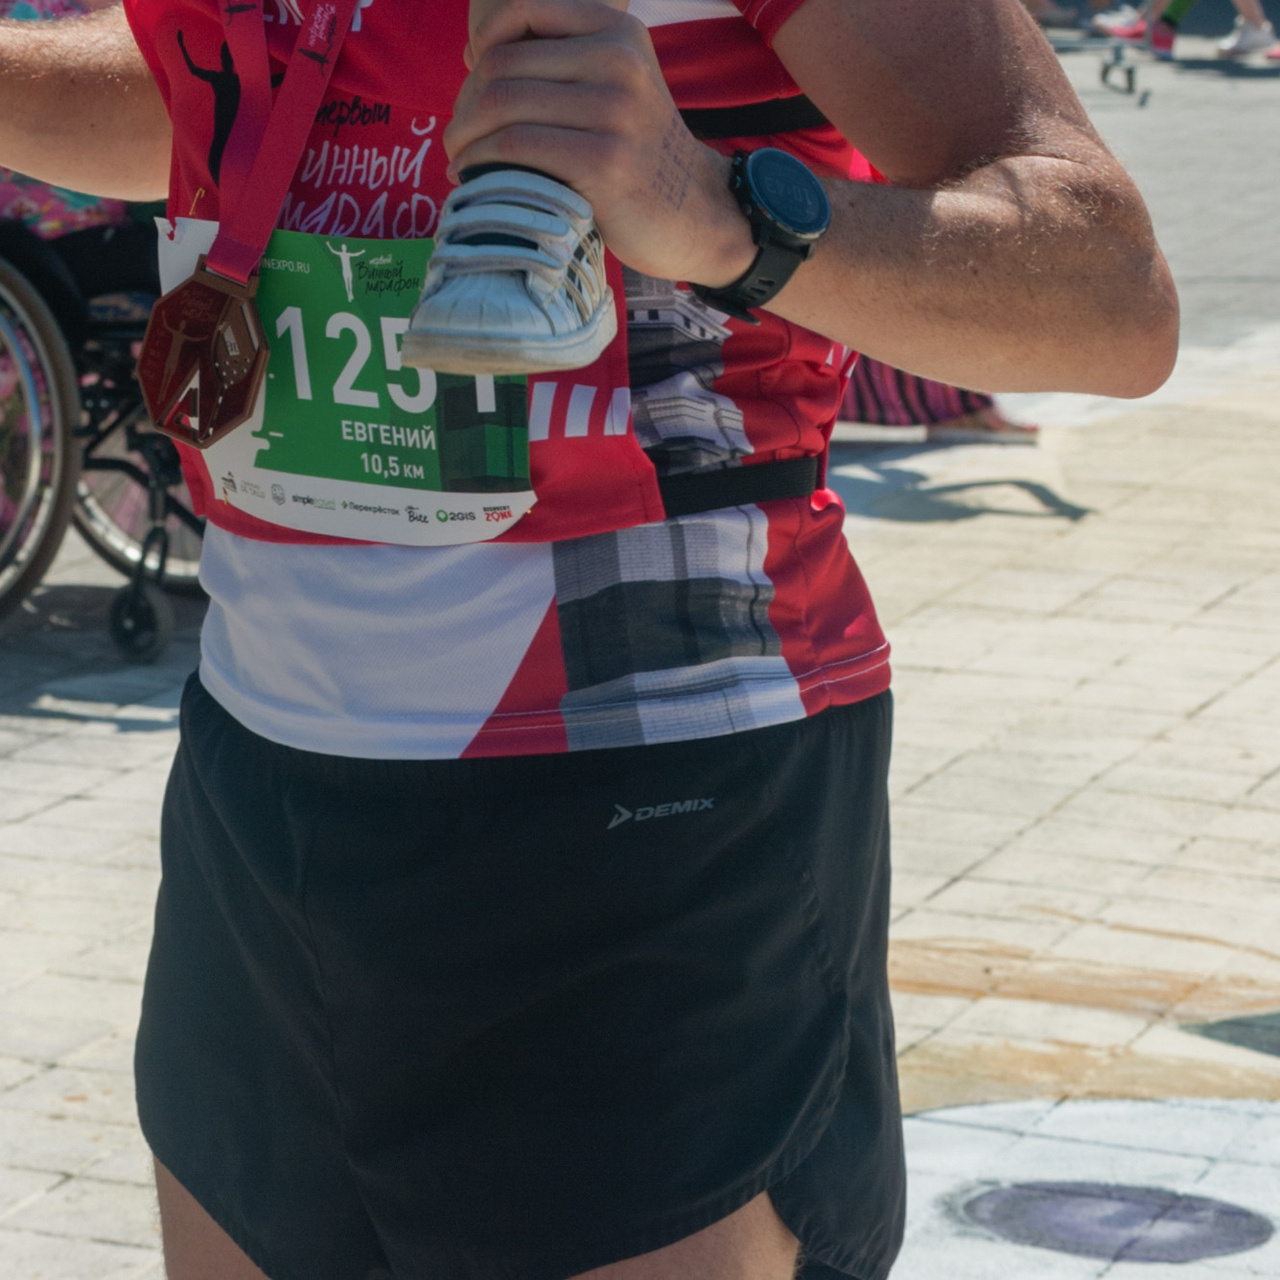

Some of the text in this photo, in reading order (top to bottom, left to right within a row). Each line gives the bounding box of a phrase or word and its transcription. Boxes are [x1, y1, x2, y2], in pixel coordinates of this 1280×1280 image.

[261, 258, 310, 274] INEXPO.RU
[341, 420, 437, 451] ЕВГЕНИЙ
[360, 452, 400, 479] 10,5
[448, 511, 476, 522] 2GIS
[634, 797, 716, 821] DEMIX
